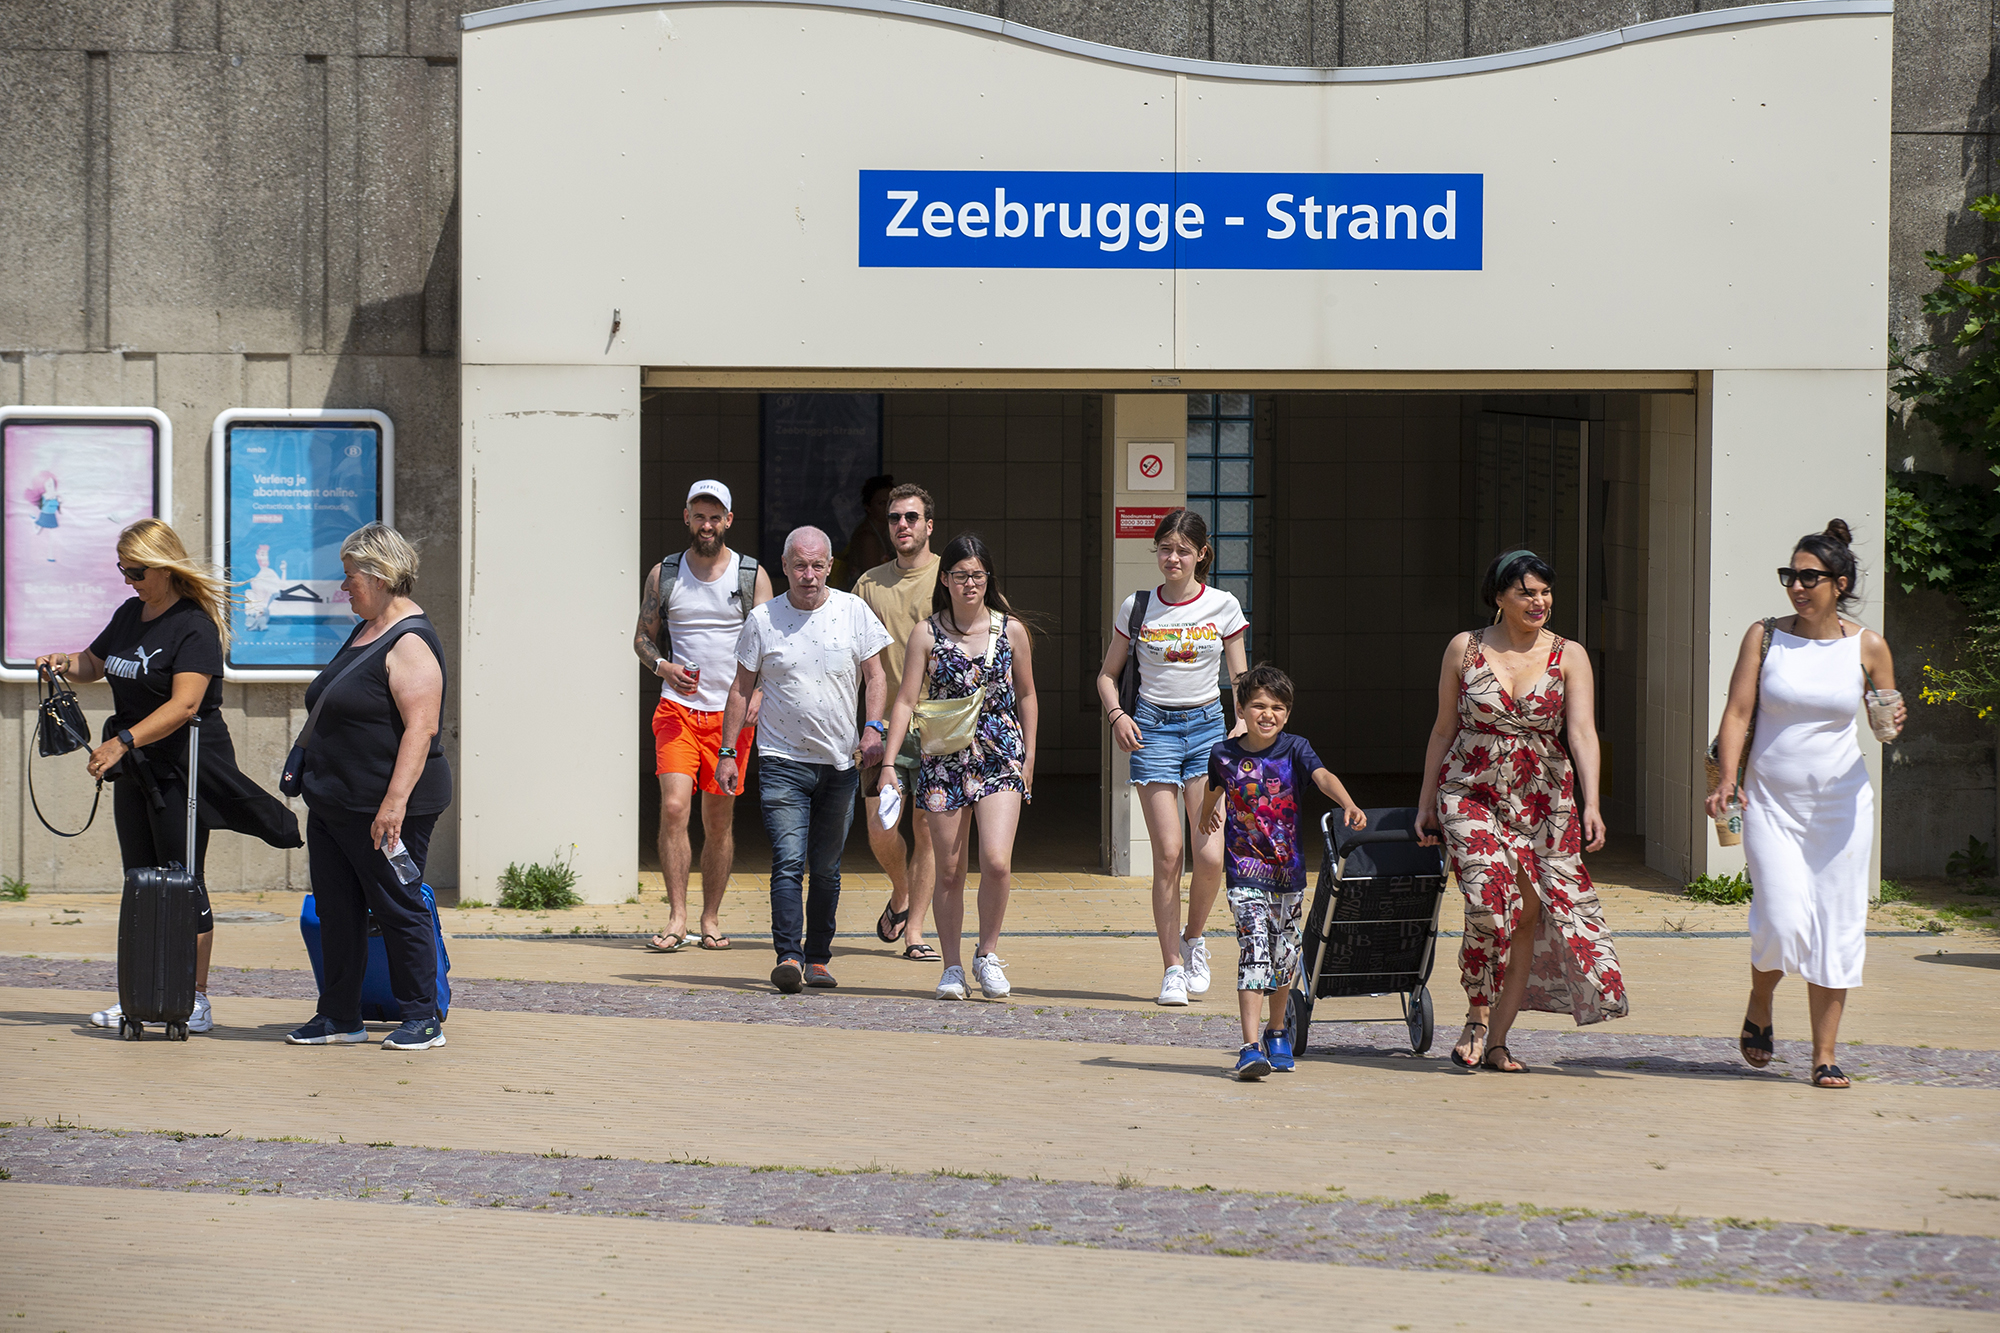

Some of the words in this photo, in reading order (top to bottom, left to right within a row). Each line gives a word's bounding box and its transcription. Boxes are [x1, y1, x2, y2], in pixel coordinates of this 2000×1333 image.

[886, 187, 1205, 252] Zeebrugge
[1225, 217, 1245, 226] -
[1266, 189, 1457, 240] Strand
[252, 474, 294, 486] Verleng
[296, 474, 307, 486] je
[253, 487, 320, 497] abonnement
[322, 487, 358, 497] online.
[1186, 622, 1218, 641] MOOD
[104, 655, 141, 679] PUMA
